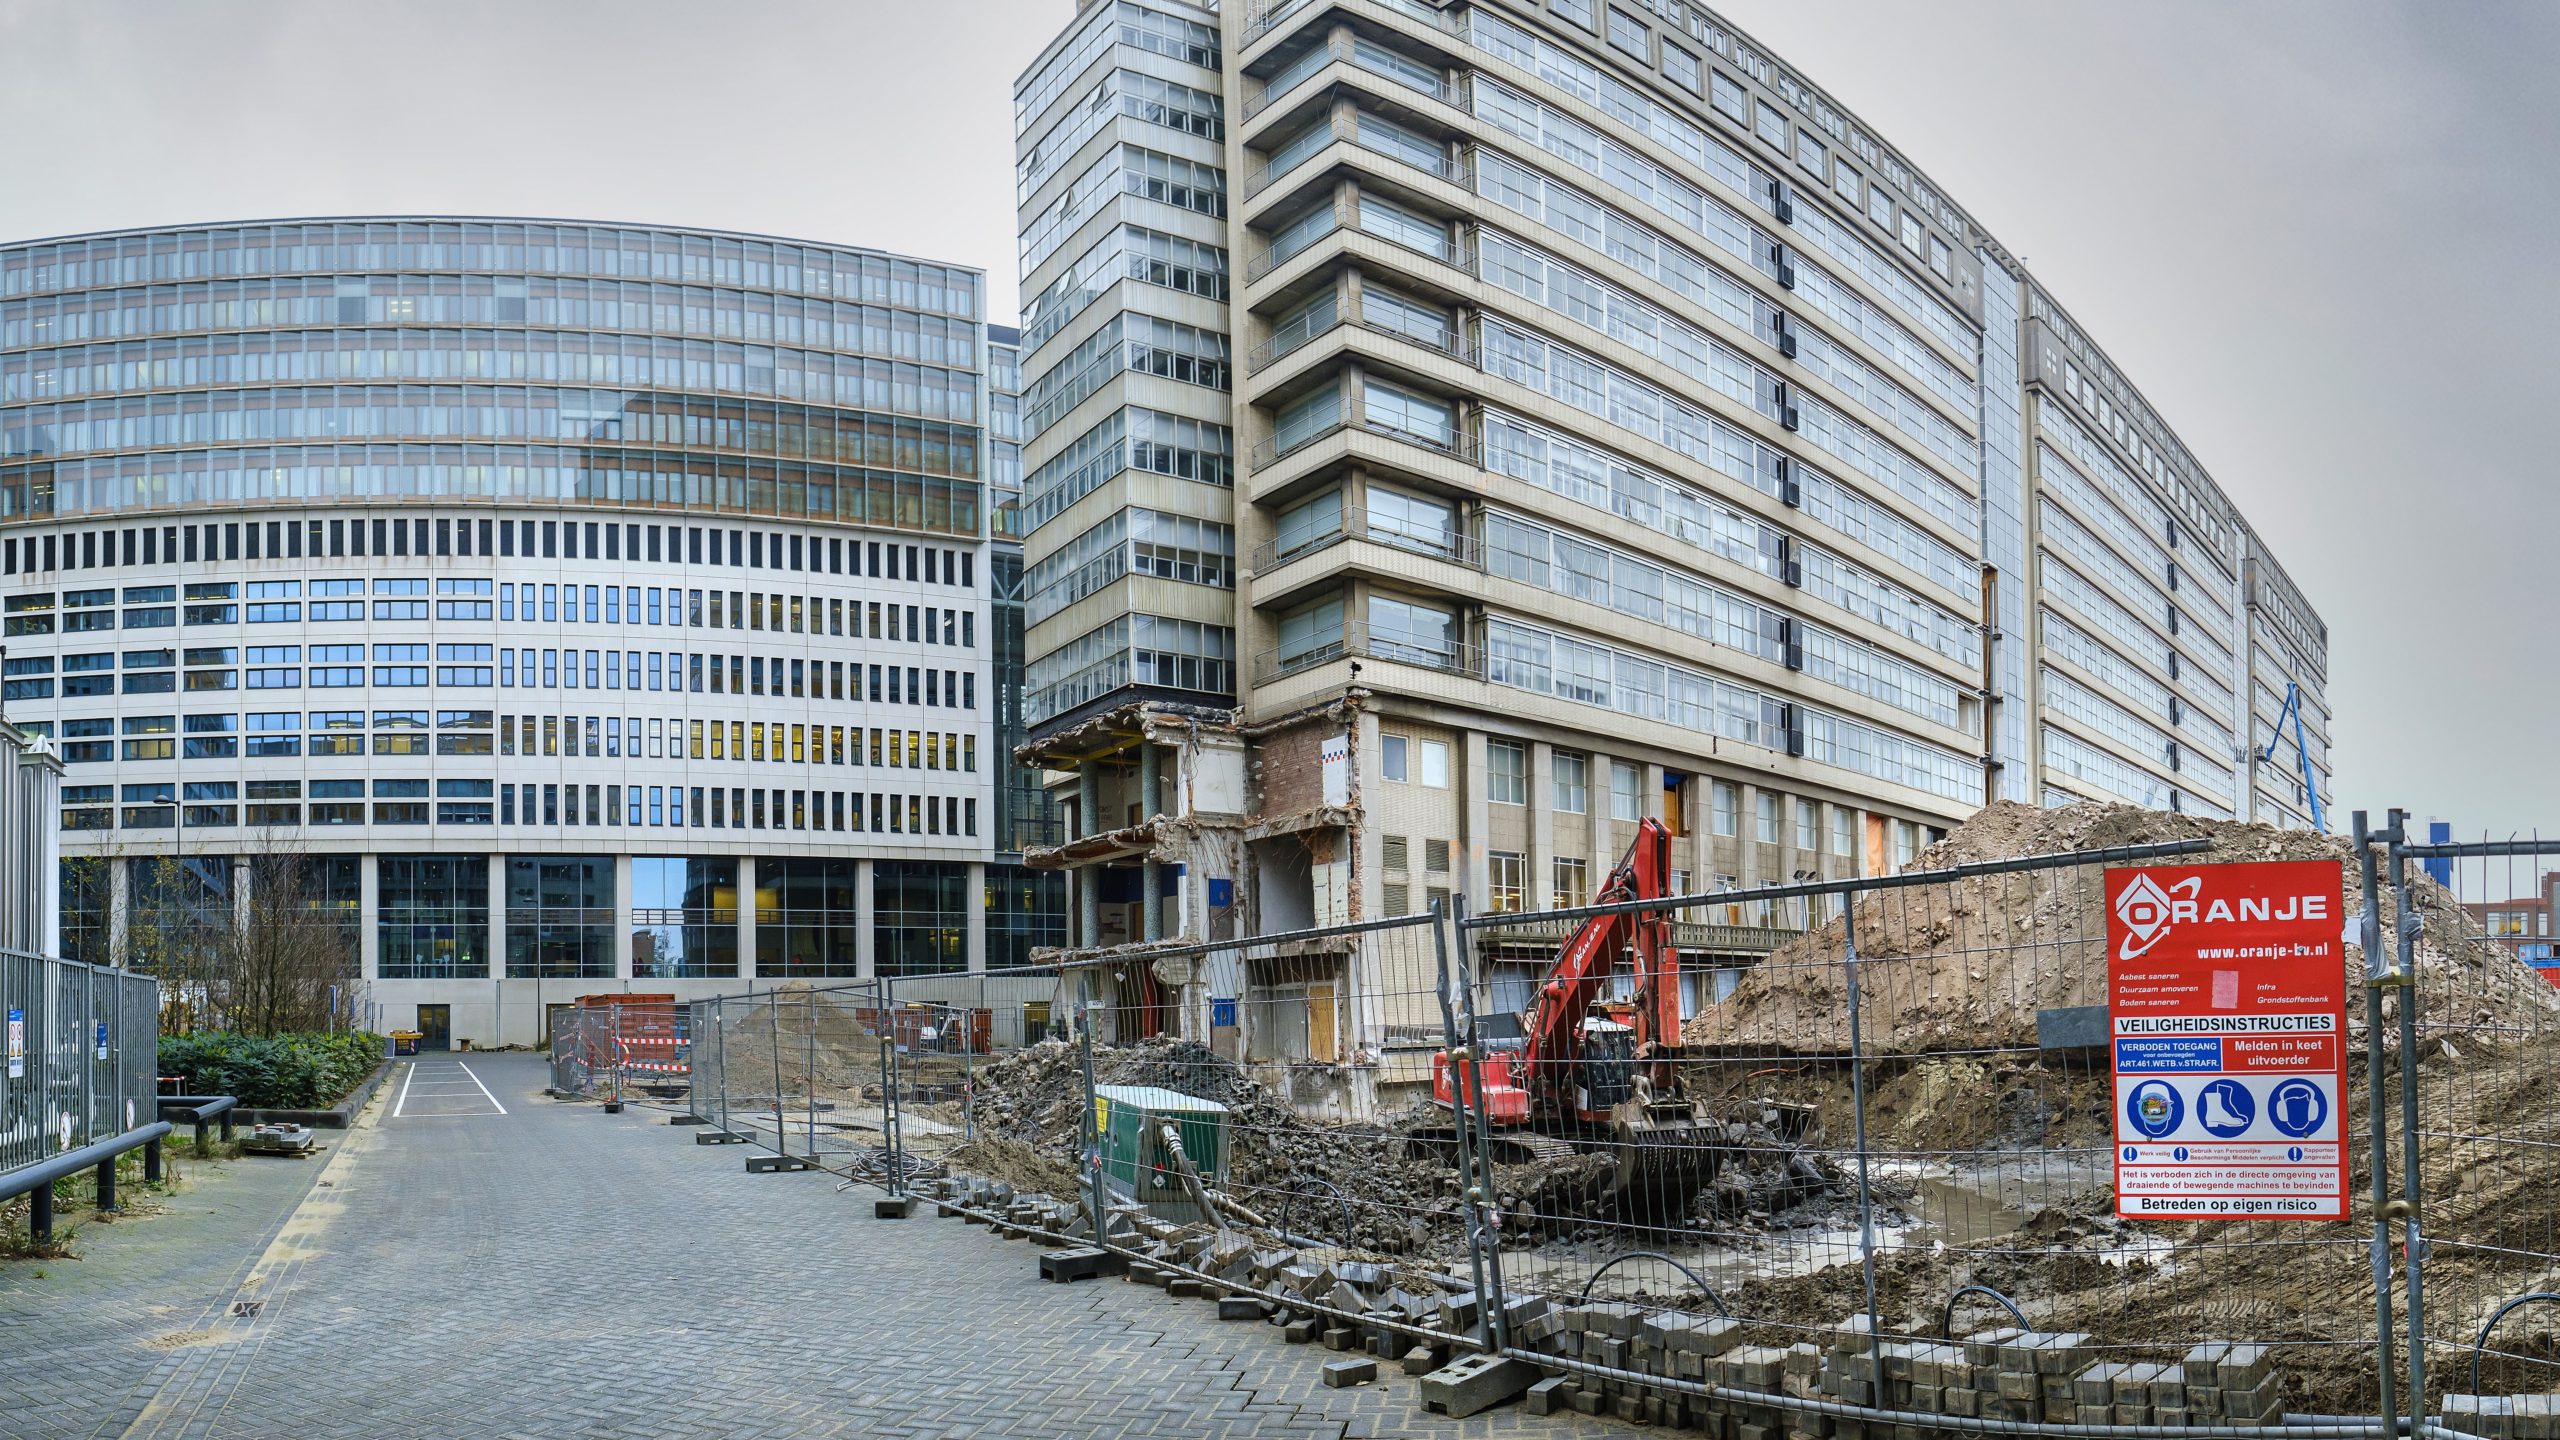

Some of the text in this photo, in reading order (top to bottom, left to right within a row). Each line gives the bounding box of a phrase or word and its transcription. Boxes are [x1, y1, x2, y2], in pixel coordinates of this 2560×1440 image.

[2127, 895, 2328, 927] ORANJE
[2119, 973, 2146, 981] Asbest
[2119, 986, 2159, 994] Duurzaam
[2257, 983, 2277, 991] Infra
[2119, 999, 2146, 1007] Bodem
[2257, 996, 2329, 1004] Grondstoffenbank
[2120, 1016, 2331, 1032] VEILIGHEIDSINSTRUCTIES
[2120, 1042, 2217, 1051] VERBODEN TOEGANG
[2234, 1040, 2323, 1051] Melden in keet
[2247, 1055, 2310, 1065] uitvoerder
[2123, 1170, 2138, 1178] Het
[2140, 1170, 2148, 1178] is
[2150, 1170, 2192, 1178] verboden
[2194, 1170, 2213, 1178] zich
[2214, 1170, 2223, 1178] in
[2225, 1170, 2237, 1178] de
[2239, 1170, 2270, 1178] directe
[2272, 1171, 2317, 1180] omgeving
[2126, 1181, 2170, 1189] draaiende
[2172, 1181, 2181, 1189] of
[2183, 1181, 2234, 1190] bewegende
[2237, 1181, 2281, 1189] machines
[2141, 1198, 2317, 1213] Betreden op eigen risico
